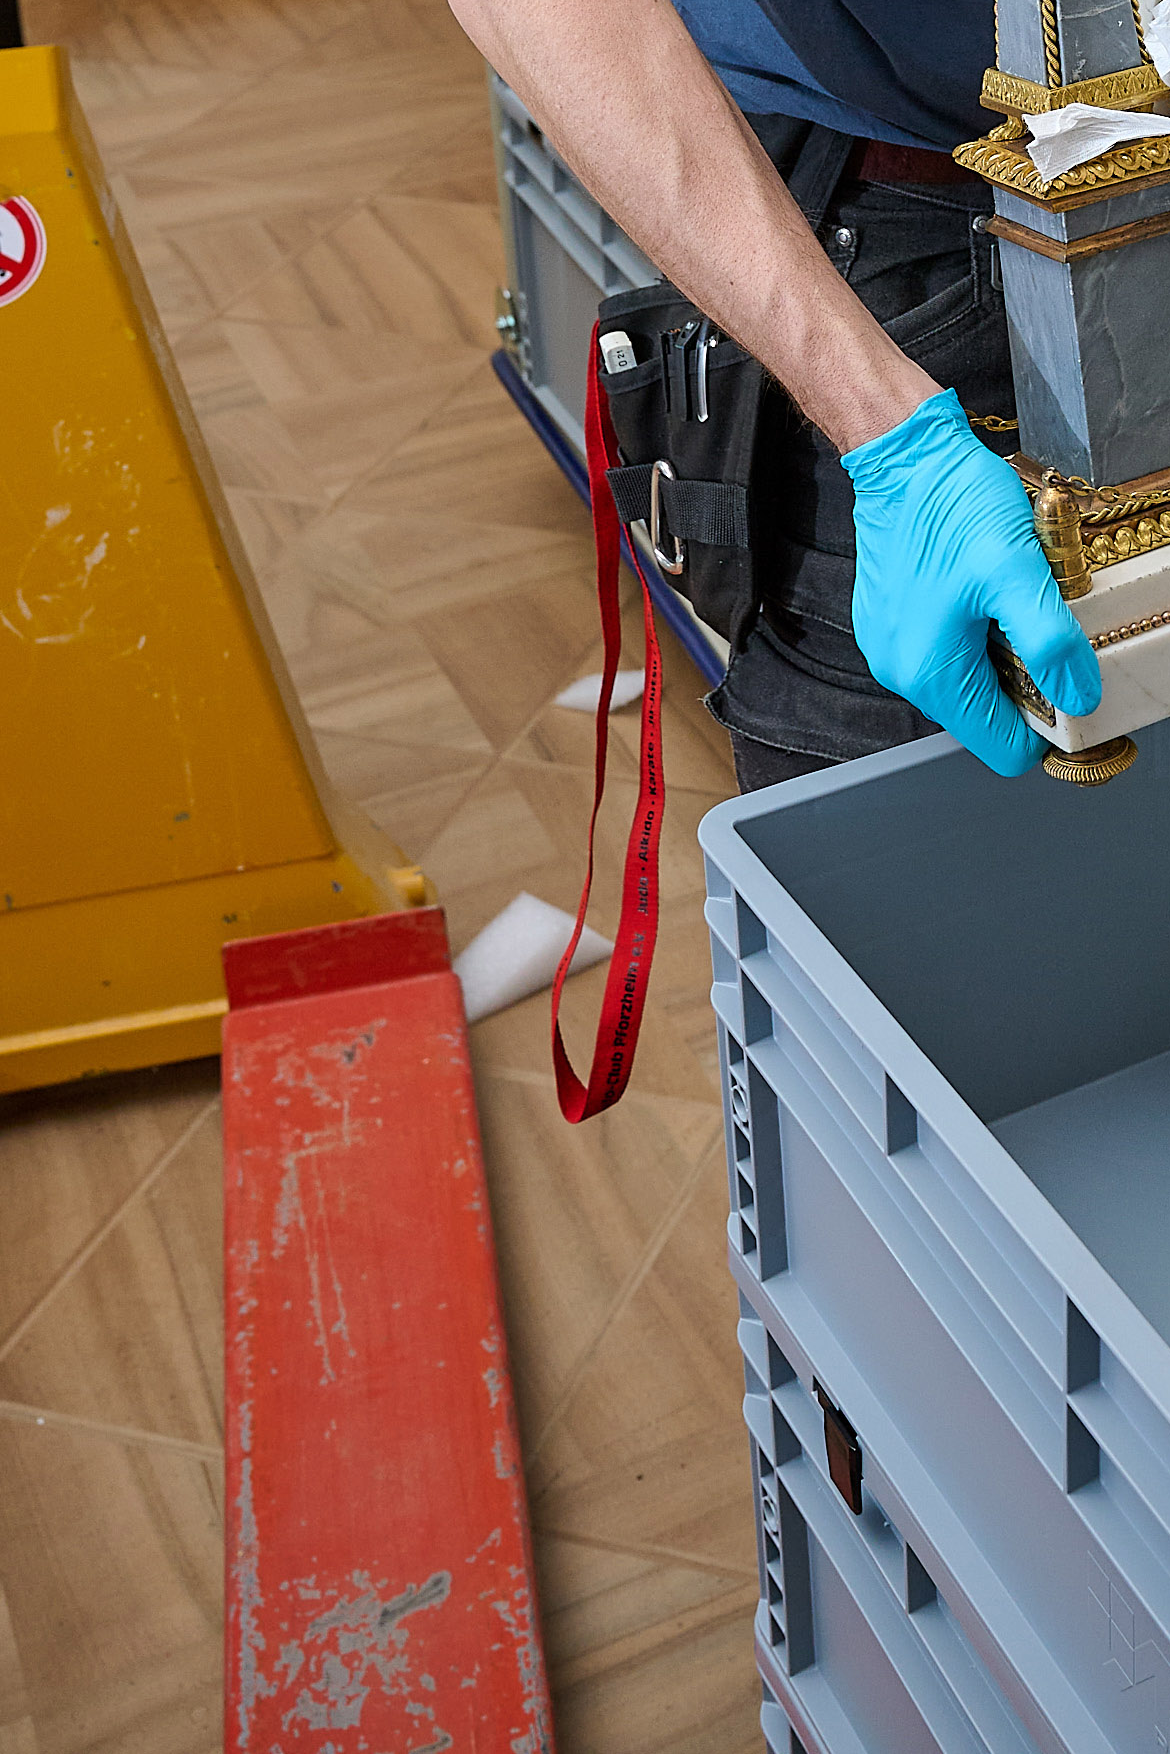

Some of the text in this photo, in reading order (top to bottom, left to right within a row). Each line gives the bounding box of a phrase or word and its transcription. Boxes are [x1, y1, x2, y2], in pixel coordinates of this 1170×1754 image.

[645, 742, 658, 796] Karate
[638, 810, 656, 863] Aikido
[637, 876, 649, 916] Judo
[613, 962, 640, 1047] Pforzheim
